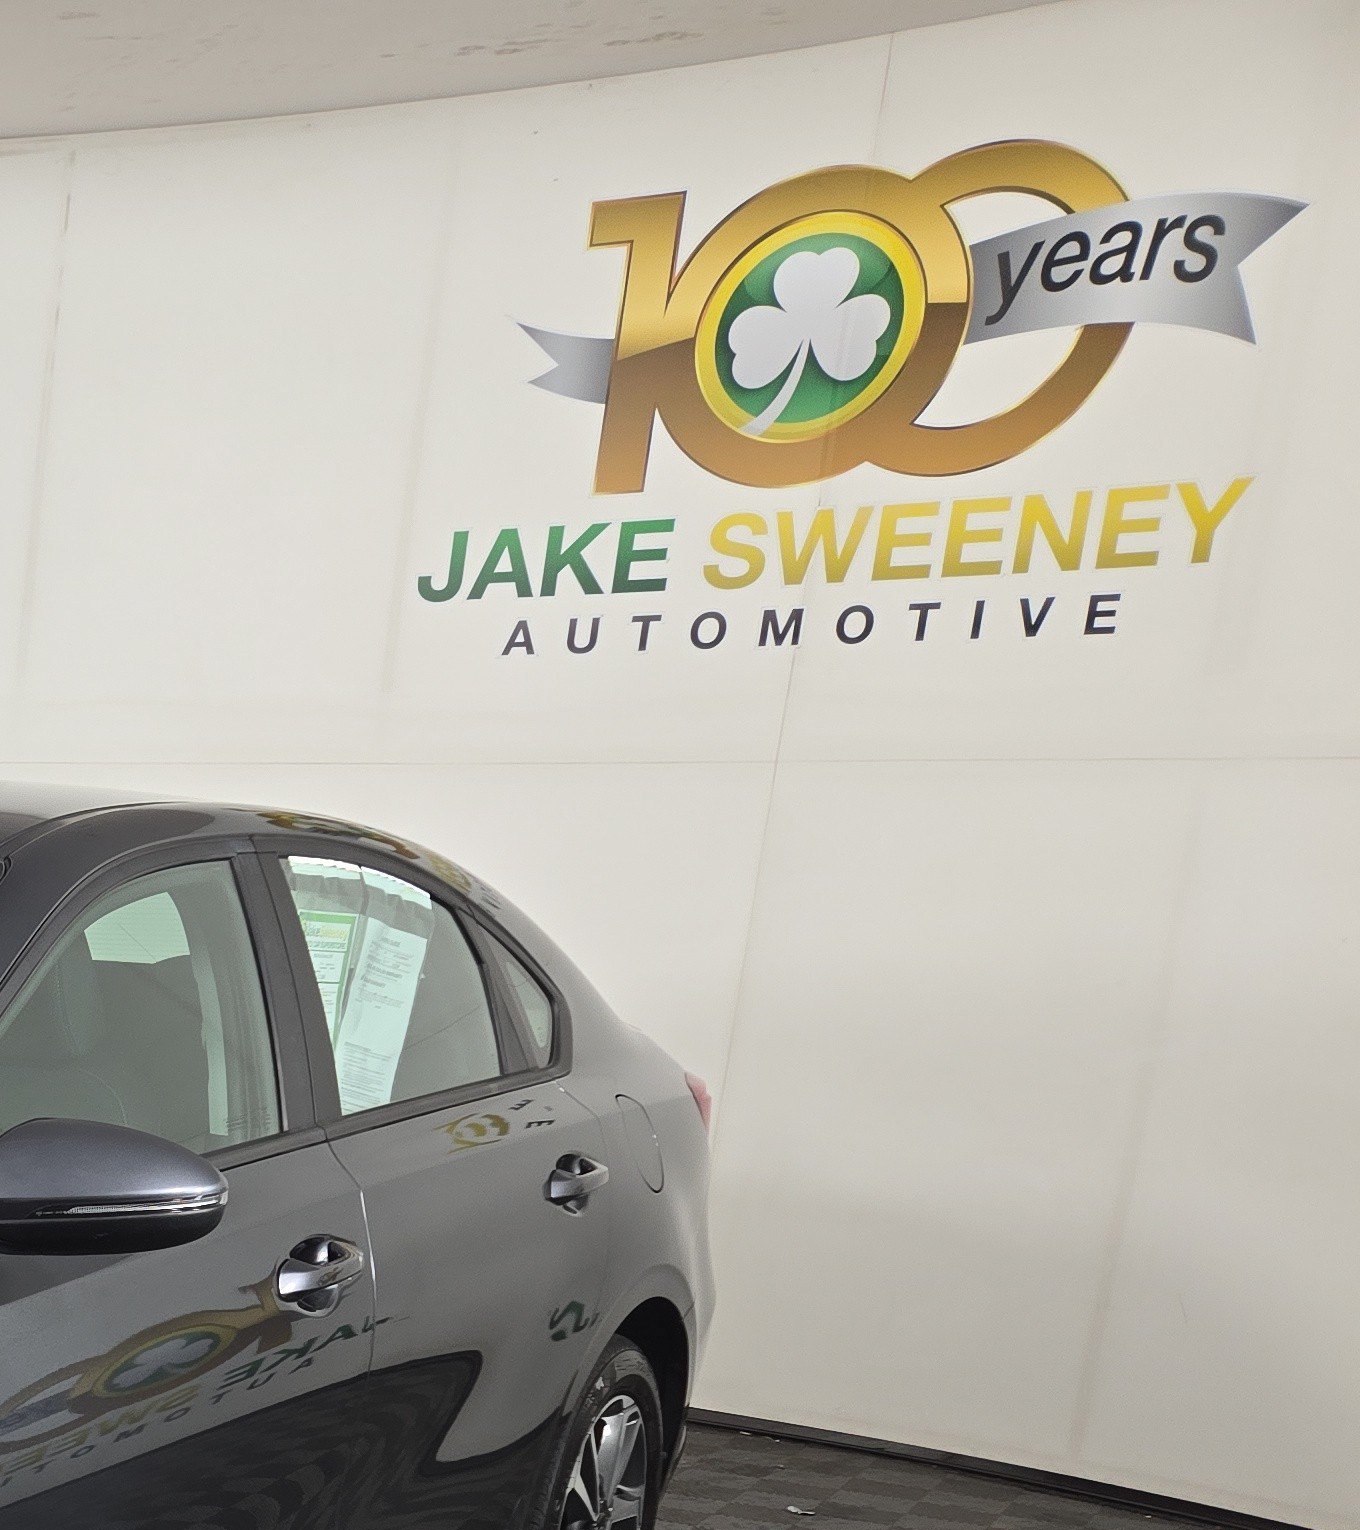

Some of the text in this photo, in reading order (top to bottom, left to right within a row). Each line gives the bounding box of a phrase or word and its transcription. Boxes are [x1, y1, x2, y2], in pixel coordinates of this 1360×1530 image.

[588, 139, 1226, 496] 100 years
[418, 476, 1255, 604] JAKE SWEENEY
[502, 593, 1124, 657] AUTOMOTIVE
